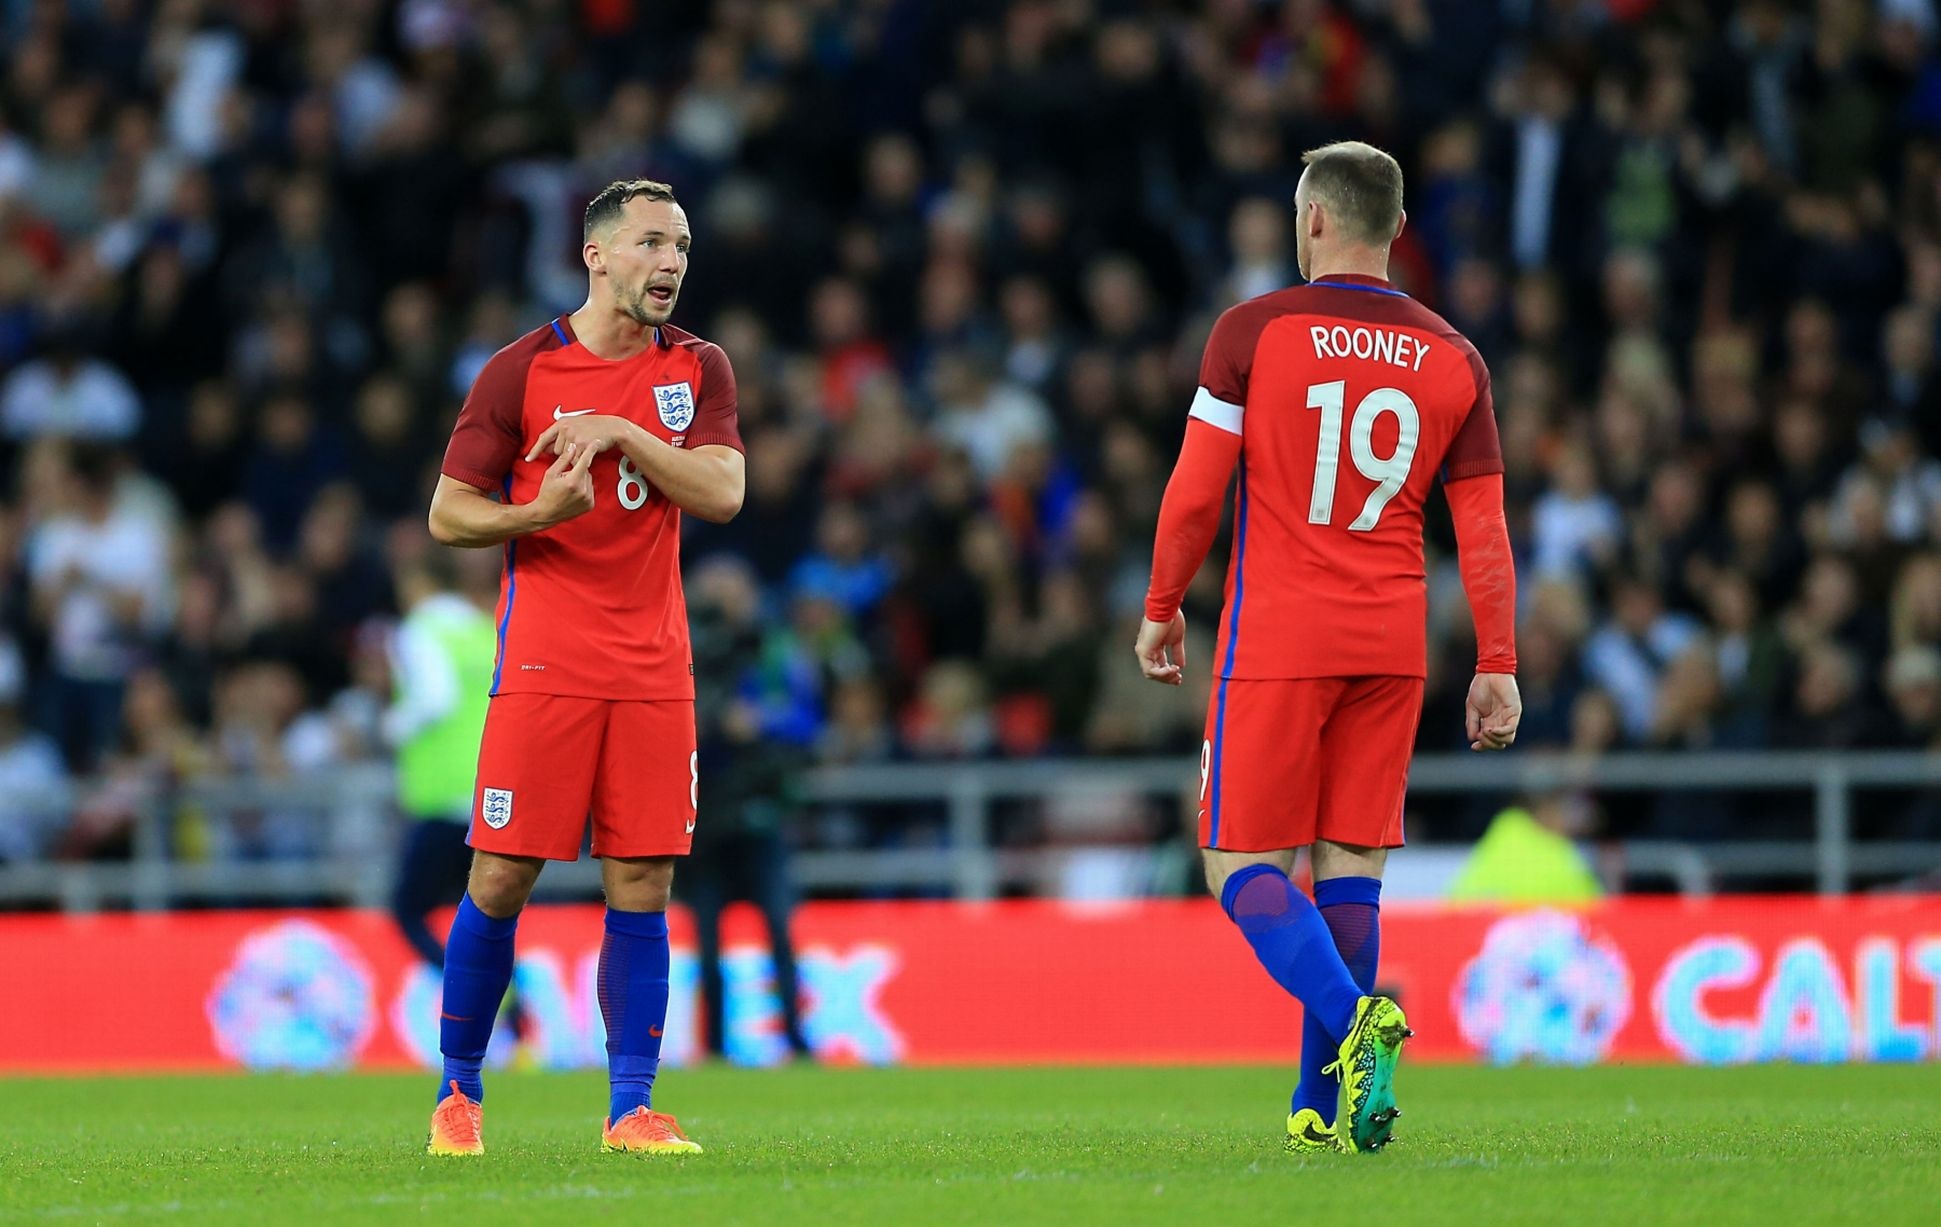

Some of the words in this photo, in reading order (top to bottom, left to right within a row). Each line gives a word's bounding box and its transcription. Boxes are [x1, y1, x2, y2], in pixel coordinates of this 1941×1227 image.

[1310, 324, 1431, 372] ROONEY
[617, 454, 649, 511] 8
[1305, 379, 1421, 532] 19
